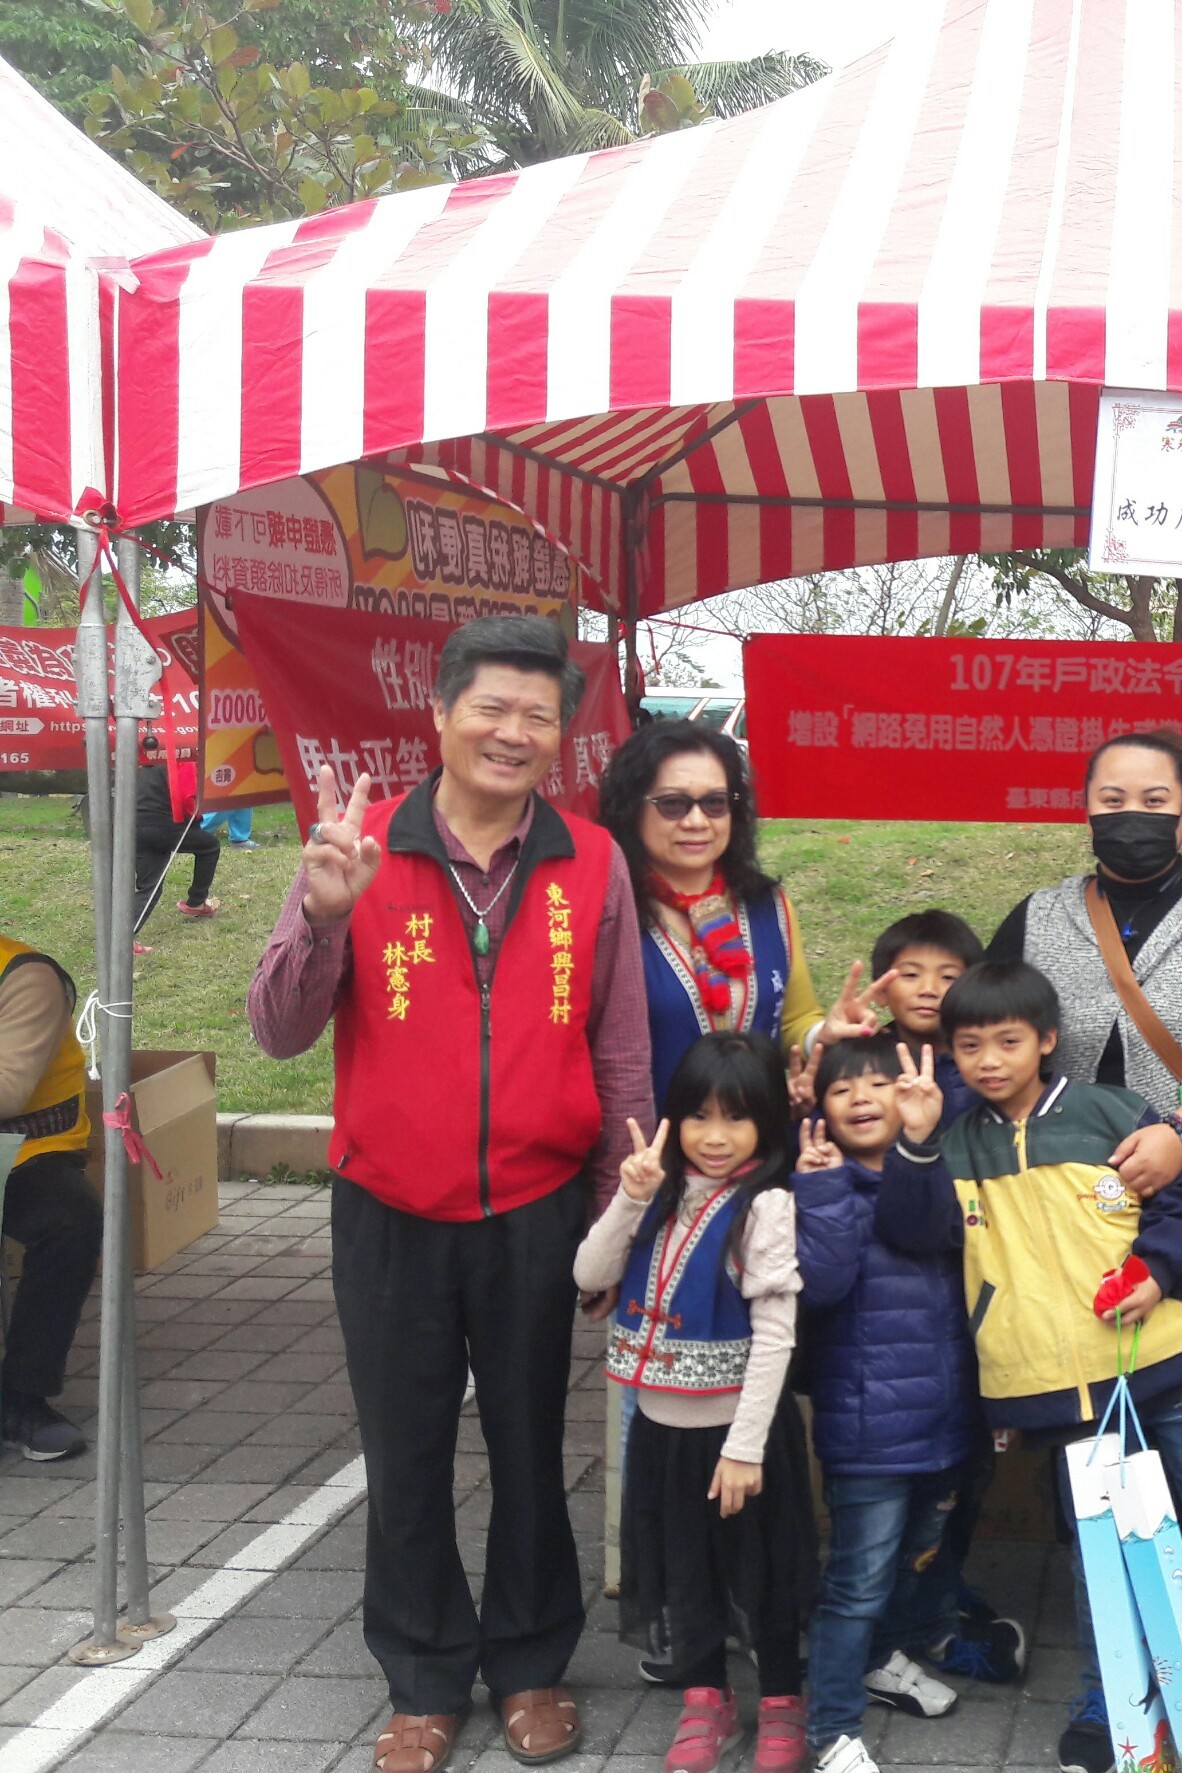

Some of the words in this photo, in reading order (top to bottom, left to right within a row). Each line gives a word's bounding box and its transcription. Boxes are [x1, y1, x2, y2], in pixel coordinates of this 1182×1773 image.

[405, 913, 436, 964] 村長
[545, 882, 575, 1024] 東河鄉興昌村
